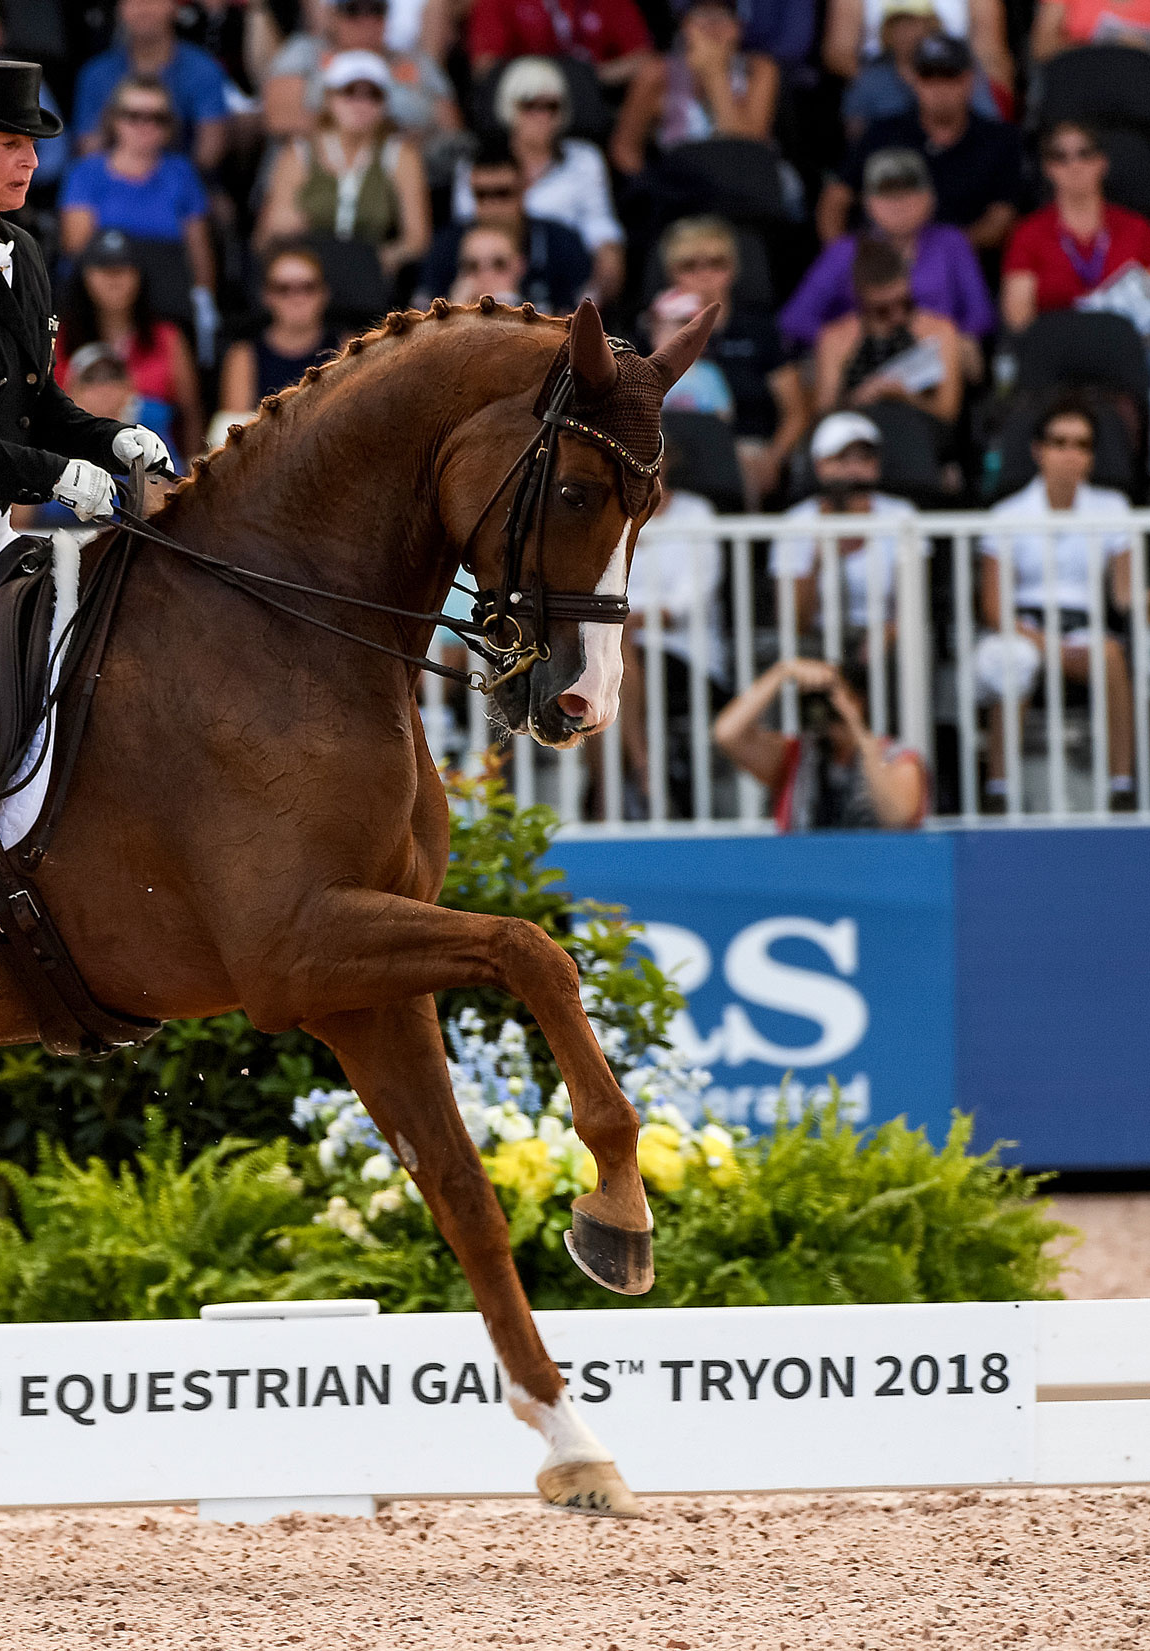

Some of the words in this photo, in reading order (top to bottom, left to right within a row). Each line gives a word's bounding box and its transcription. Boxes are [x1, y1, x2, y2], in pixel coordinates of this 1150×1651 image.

[20, 1363, 391, 1426] EQUESTRIAN
[660, 1356, 856, 1402] TRYON
[874, 1352, 1011, 1397] 2018
